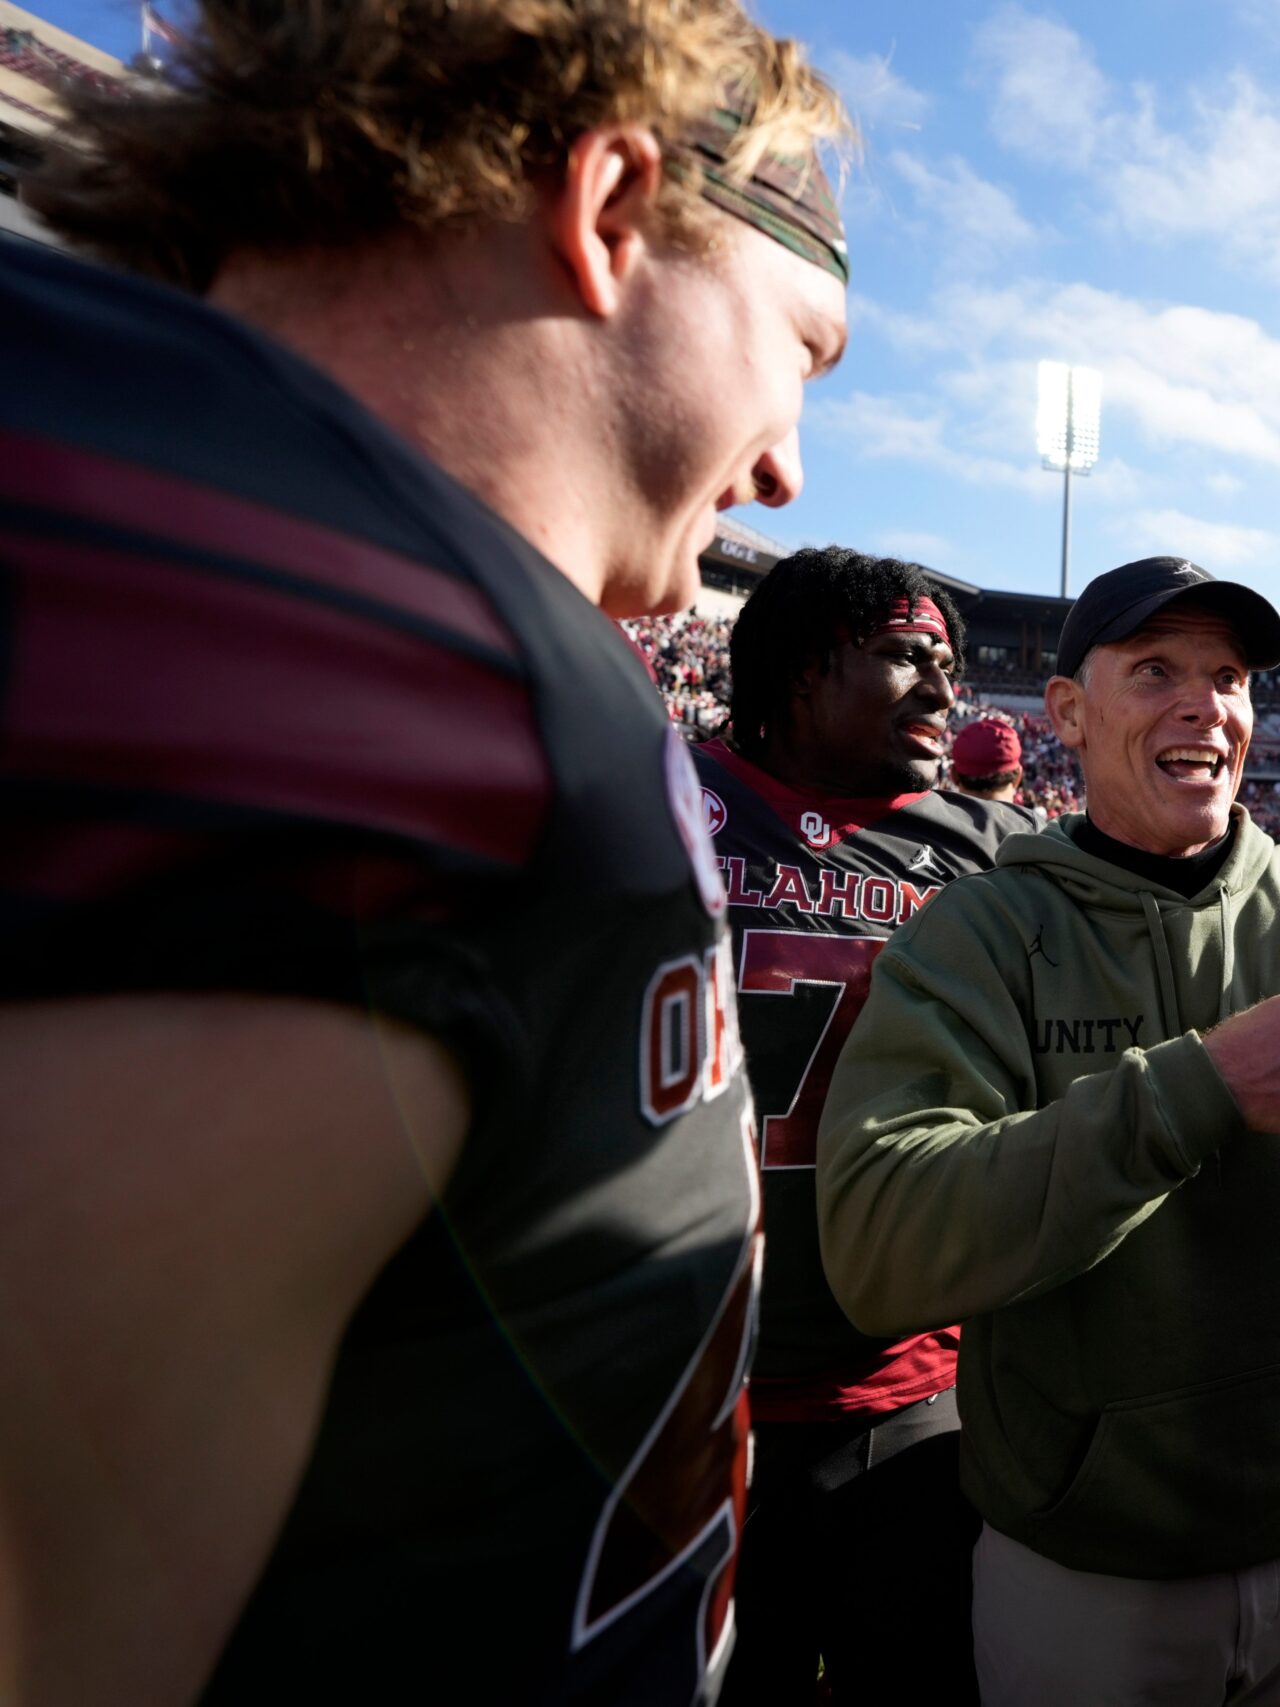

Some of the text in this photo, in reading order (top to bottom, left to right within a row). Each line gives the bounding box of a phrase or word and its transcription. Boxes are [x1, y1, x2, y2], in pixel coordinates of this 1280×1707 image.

[800, 811, 830, 846] OU
[714, 855, 945, 926] LAHOM
[1033, 1014, 1144, 1054] UNITY
